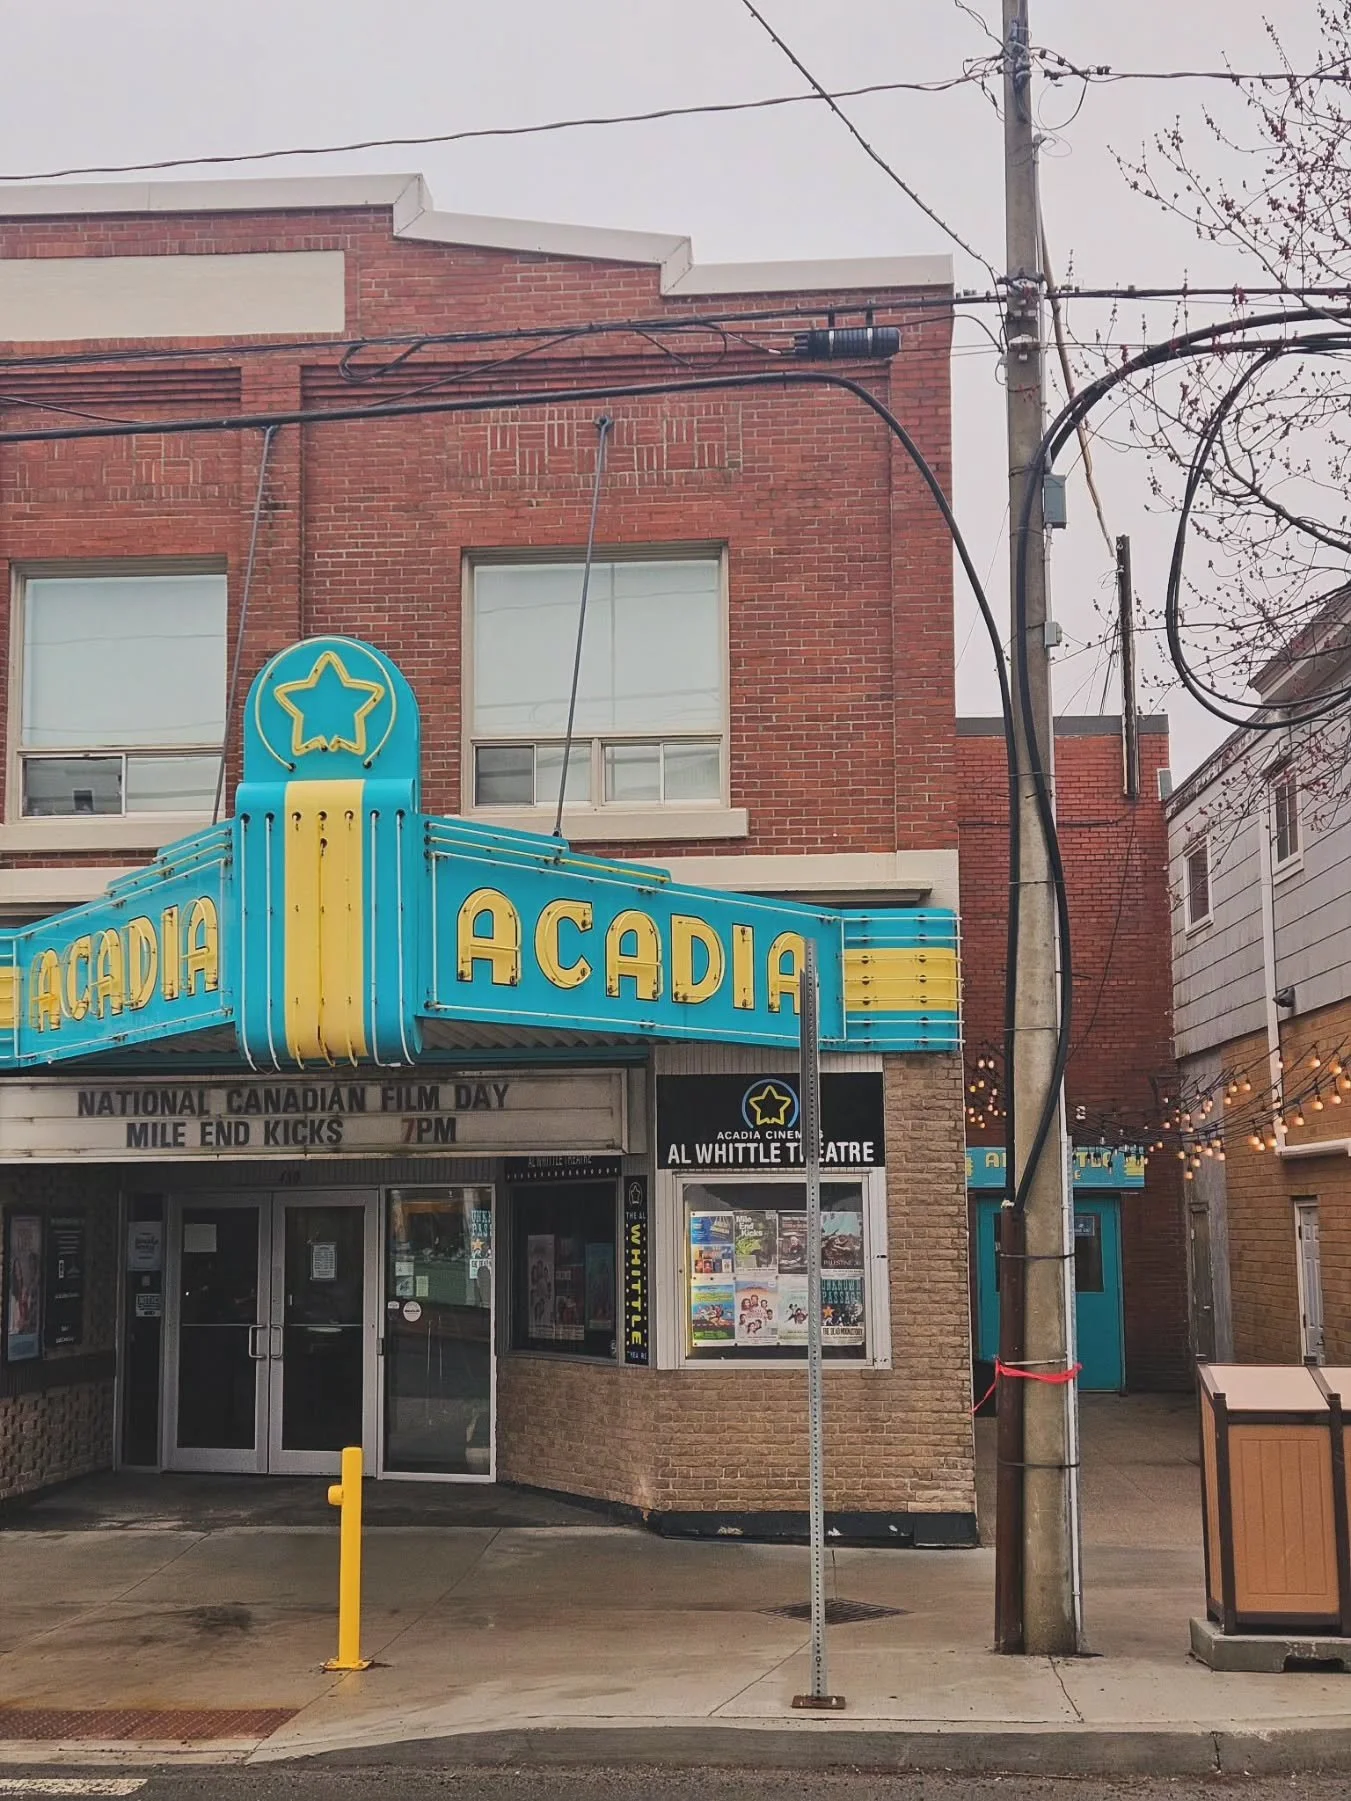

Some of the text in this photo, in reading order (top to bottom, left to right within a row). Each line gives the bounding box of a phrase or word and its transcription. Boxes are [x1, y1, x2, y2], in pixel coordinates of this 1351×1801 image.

[456, 886, 806, 1016] ACADIA
[29, 895, 219, 1033] ACADIA
[77, 1082, 509, 1118] NATIONAL CANADIAN FILM DAY
[126, 1117, 457, 1149] MILE END KICKS 7PM
[717, 1130, 824, 1140] ACADIA CINEMS
[667, 1143, 691, 1165] AL
[696, 1142, 781, 1164] WHITTLE
[626, 1211, 637, 1220] THE
[739, 1222, 754, 1230] End
[741, 1229, 763, 1237] Kicks
[631, 1223, 642, 1345] WHITTLE
[821, 1279, 862, 1291] UNKNOWN
[822, 1291, 862, 1305] PASSAGE
